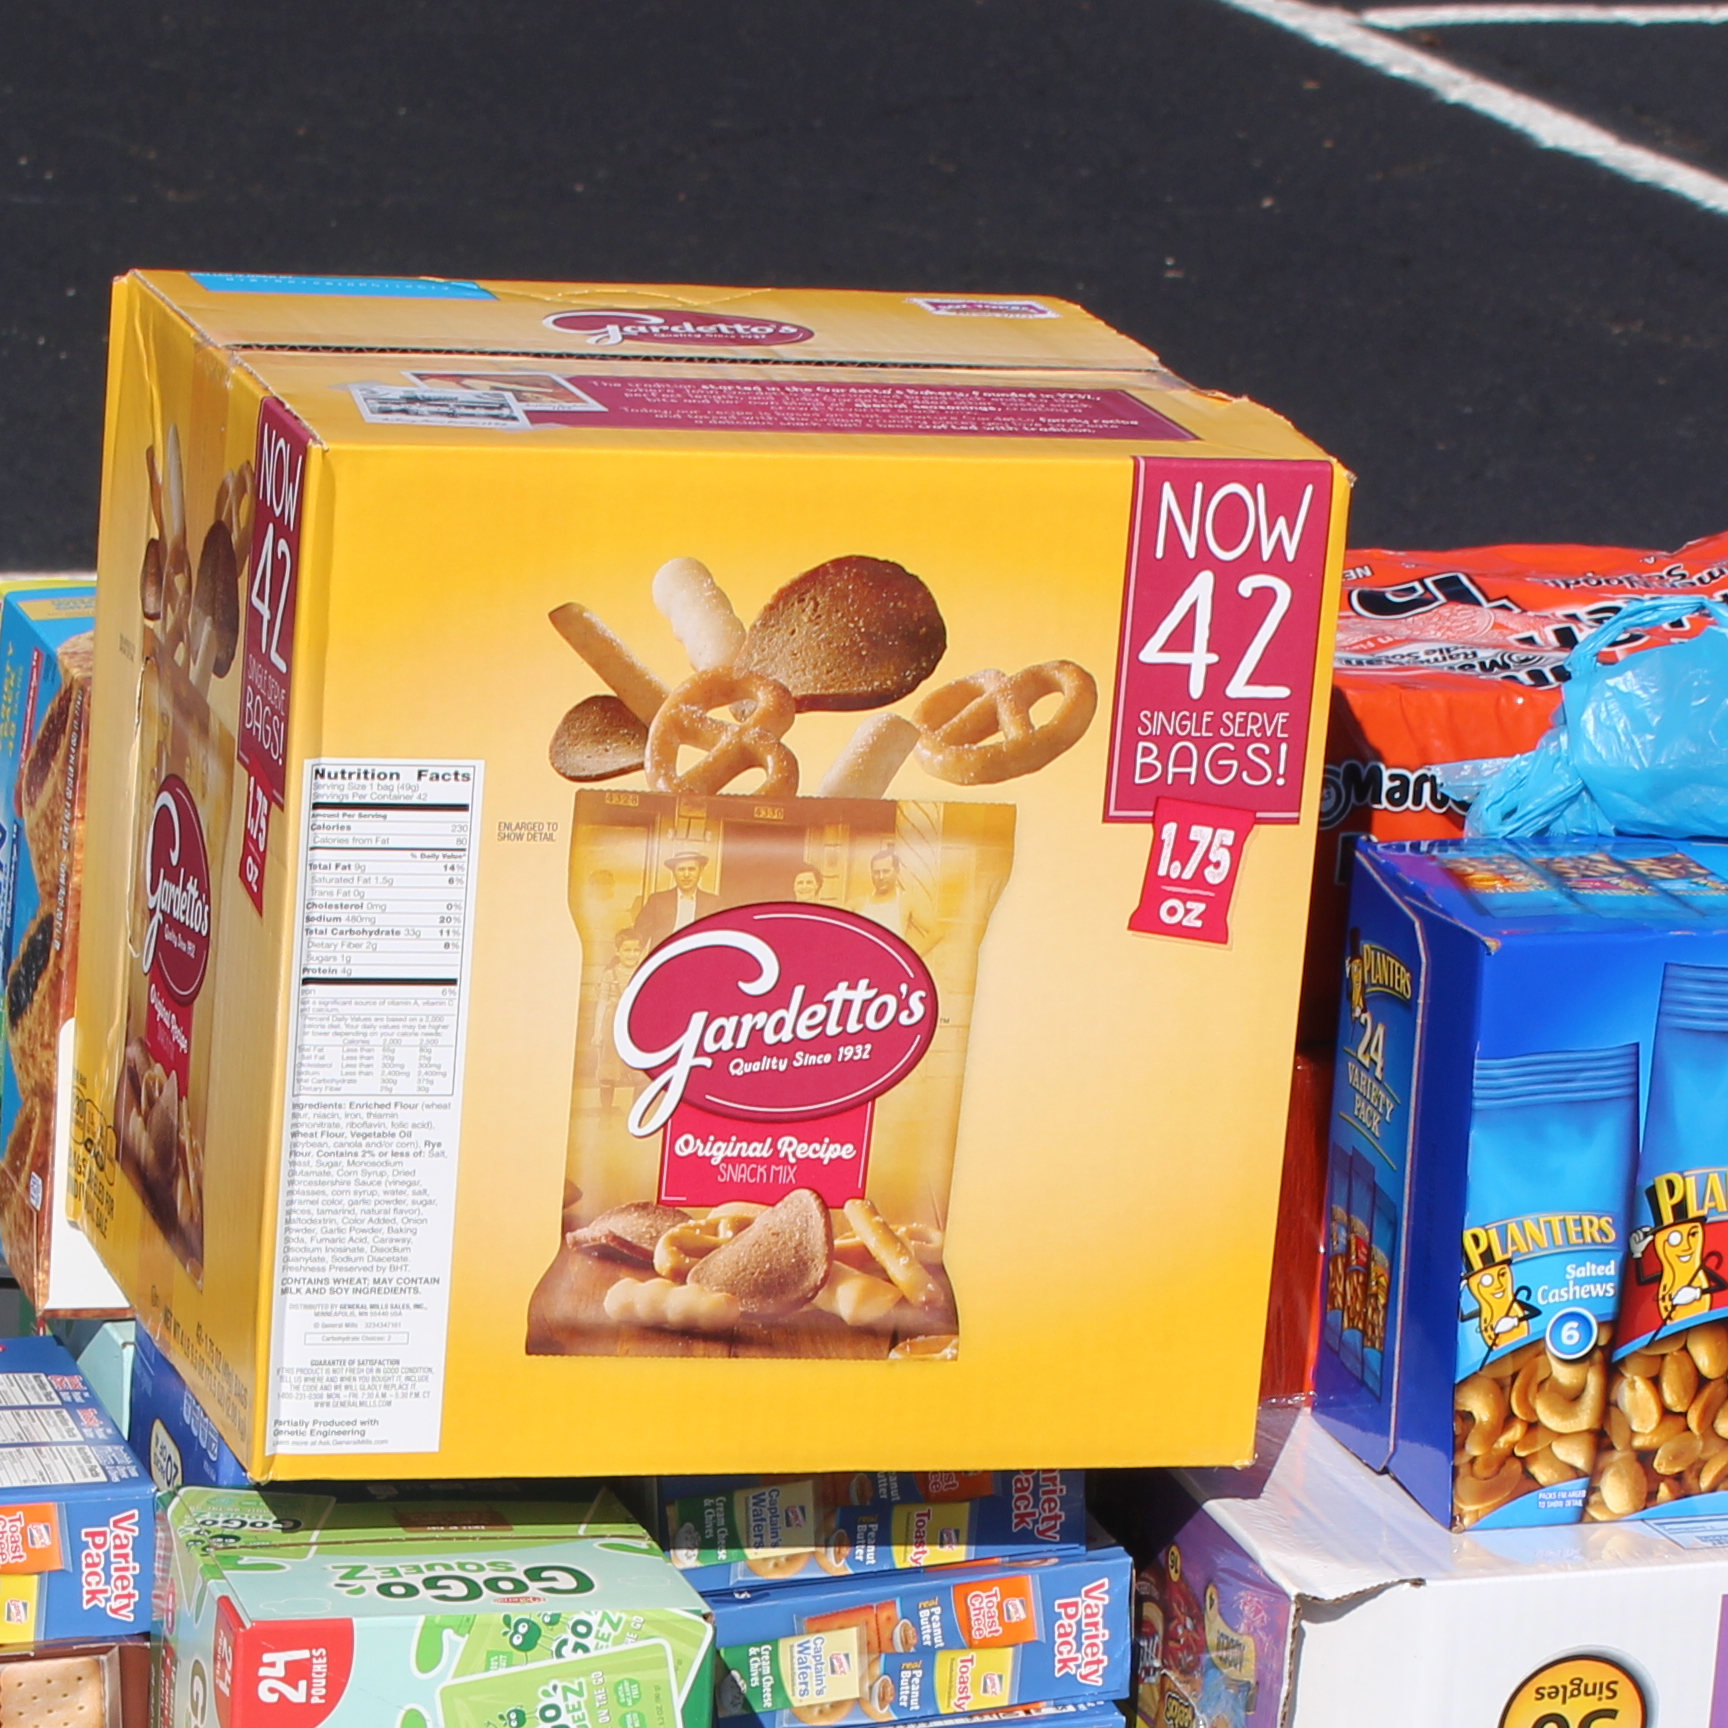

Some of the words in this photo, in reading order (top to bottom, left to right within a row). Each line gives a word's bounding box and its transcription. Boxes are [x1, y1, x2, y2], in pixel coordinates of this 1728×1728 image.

[543, 308, 799, 346] Gardetto's
[259, 422, 302, 532] NOW
[1155, 481, 1313, 563] NOW
[250, 523, 293, 675] 42
[1137, 569, 1292, 700] 42
[245, 694, 286, 767] BAGS!
[1137, 710, 1214, 738] SINGLE
[1220, 712, 1289, 738] SERVE
[313, 768, 400, 782] Nutrition
[417, 769, 471, 782] Facts
[1133, 741, 1288, 787] BAGS!
[248, 775, 268, 855] 1.75
[497, 832, 524, 841] SHOW
[526, 832, 556, 842] DETAIL
[498, 822, 543, 831] ENLARGED
[546, 822, 558, 831] TO
[1156, 821, 1234, 885] 1.75
[142, 791, 209, 976] Gardetto's
[1364, 945, 1412, 999] PLANTERS
[613, 929, 927, 1138] Gardetto's
[728, 1055, 788, 1077] Quality
[793, 1050, 832, 1069] Since
[837, 1044, 871, 1063] 1932
[1356, 1013, 1386, 1080] 24
[1346, 1062, 1395, 1124] VARIETY
[1353, 1096, 1381, 1136] PACK
[674, 1134, 772, 1165] Original
[777, 1135, 856, 1162] Recipe
[718, 1164, 767, 1184] SNACK
[771, 1165, 797, 1184] MIX
[1463, 1216, 1616, 1274] PLANTERS
[1566, 1261, 1615, 1279] Salted
[1537, 1279, 1615, 1305] Cashews
[1561, 1321, 1580, 1345] 6
[81, 1529, 110, 1609] Pack
[105, 1508, 140, 1621] Variety
[258, 1649, 311, 1705] 24
[311, 1647, 327, 1703] POUCHES
[1534, 1677, 1618, 1704] Singles
